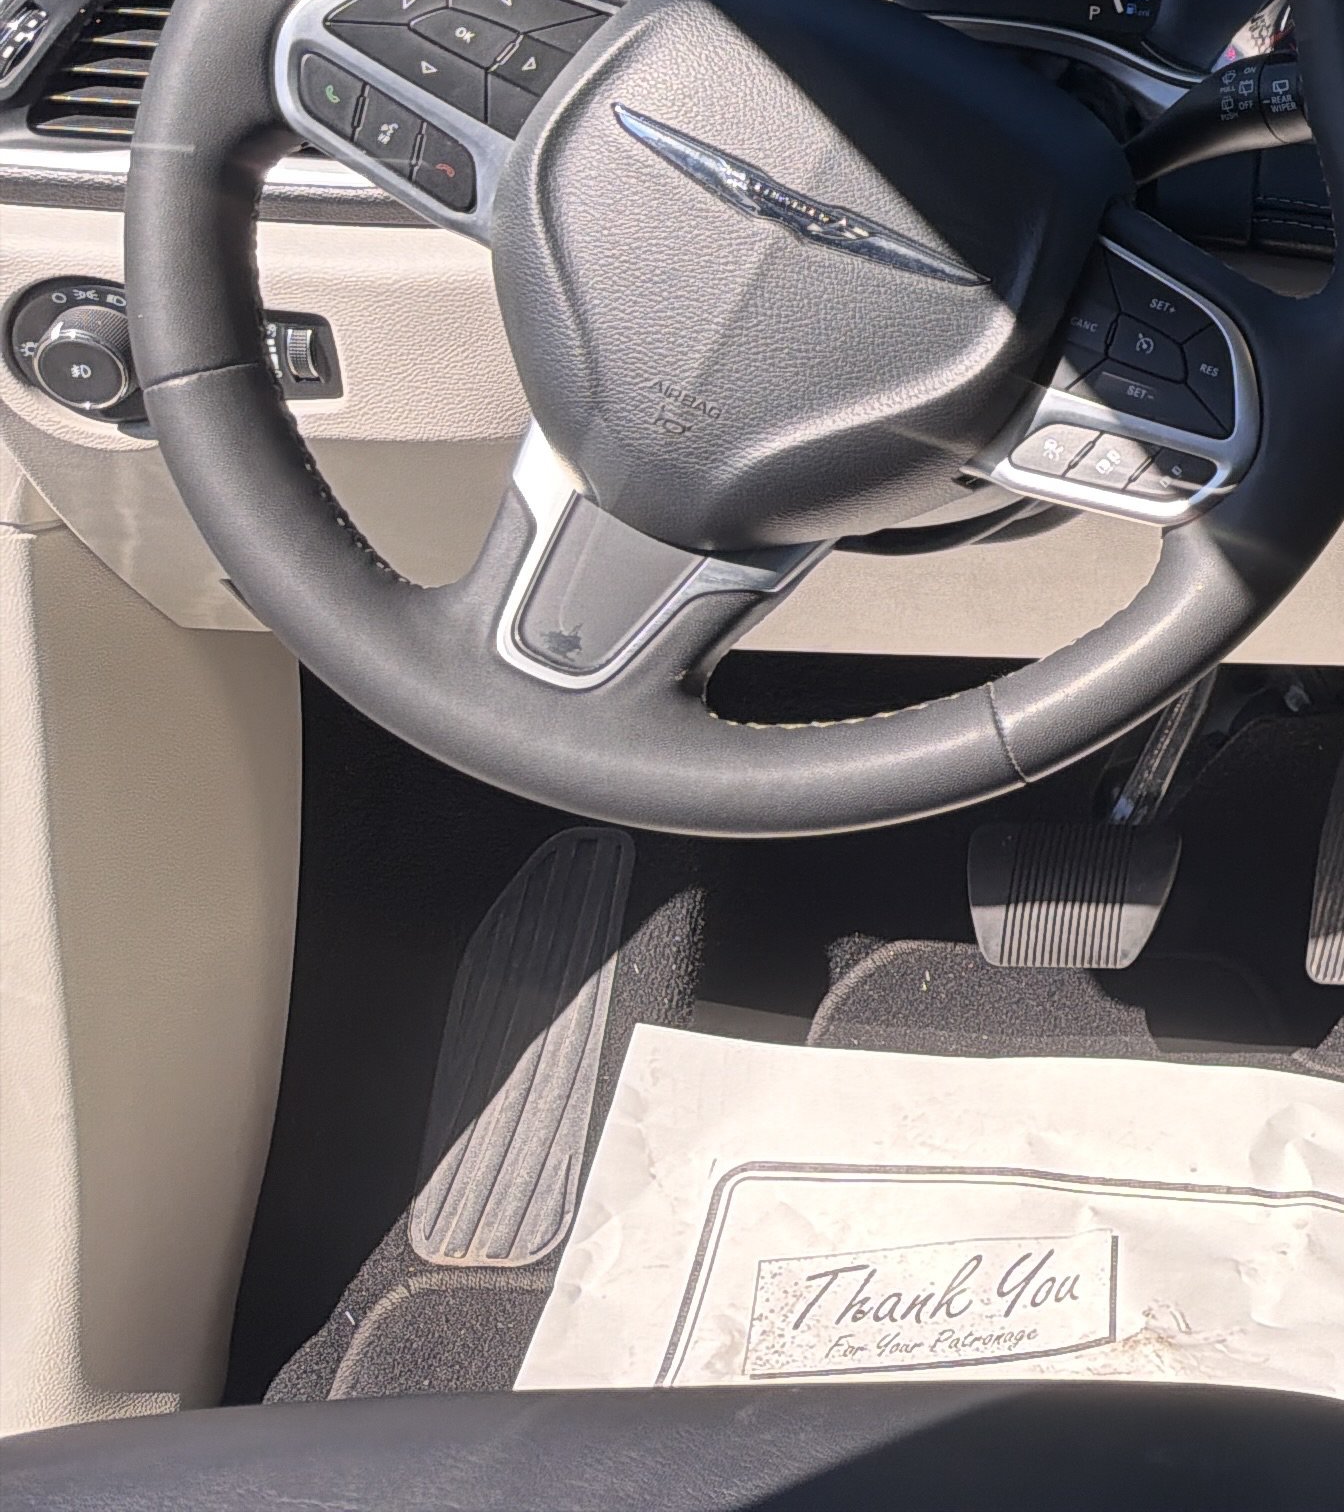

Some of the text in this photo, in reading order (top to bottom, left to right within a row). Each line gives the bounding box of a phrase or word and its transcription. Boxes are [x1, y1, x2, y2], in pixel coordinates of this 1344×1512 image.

[1088, 5, 1101, 21] P
[454, 26, 475, 44] OK
[1238, 100, 1254, 111] OFF
[1271, 93, 1293, 104] REAR
[1270, 101, 1297, 113] WIPER
[1070, 316, 1099, 333] CANC
[1199, 363, 1220, 378] RES
[649, 379, 723, 420] AIRBAG
[791, 1248, 1081, 1332] Thank You
[823, 1326, 1039, 1360] For Your Patronage
